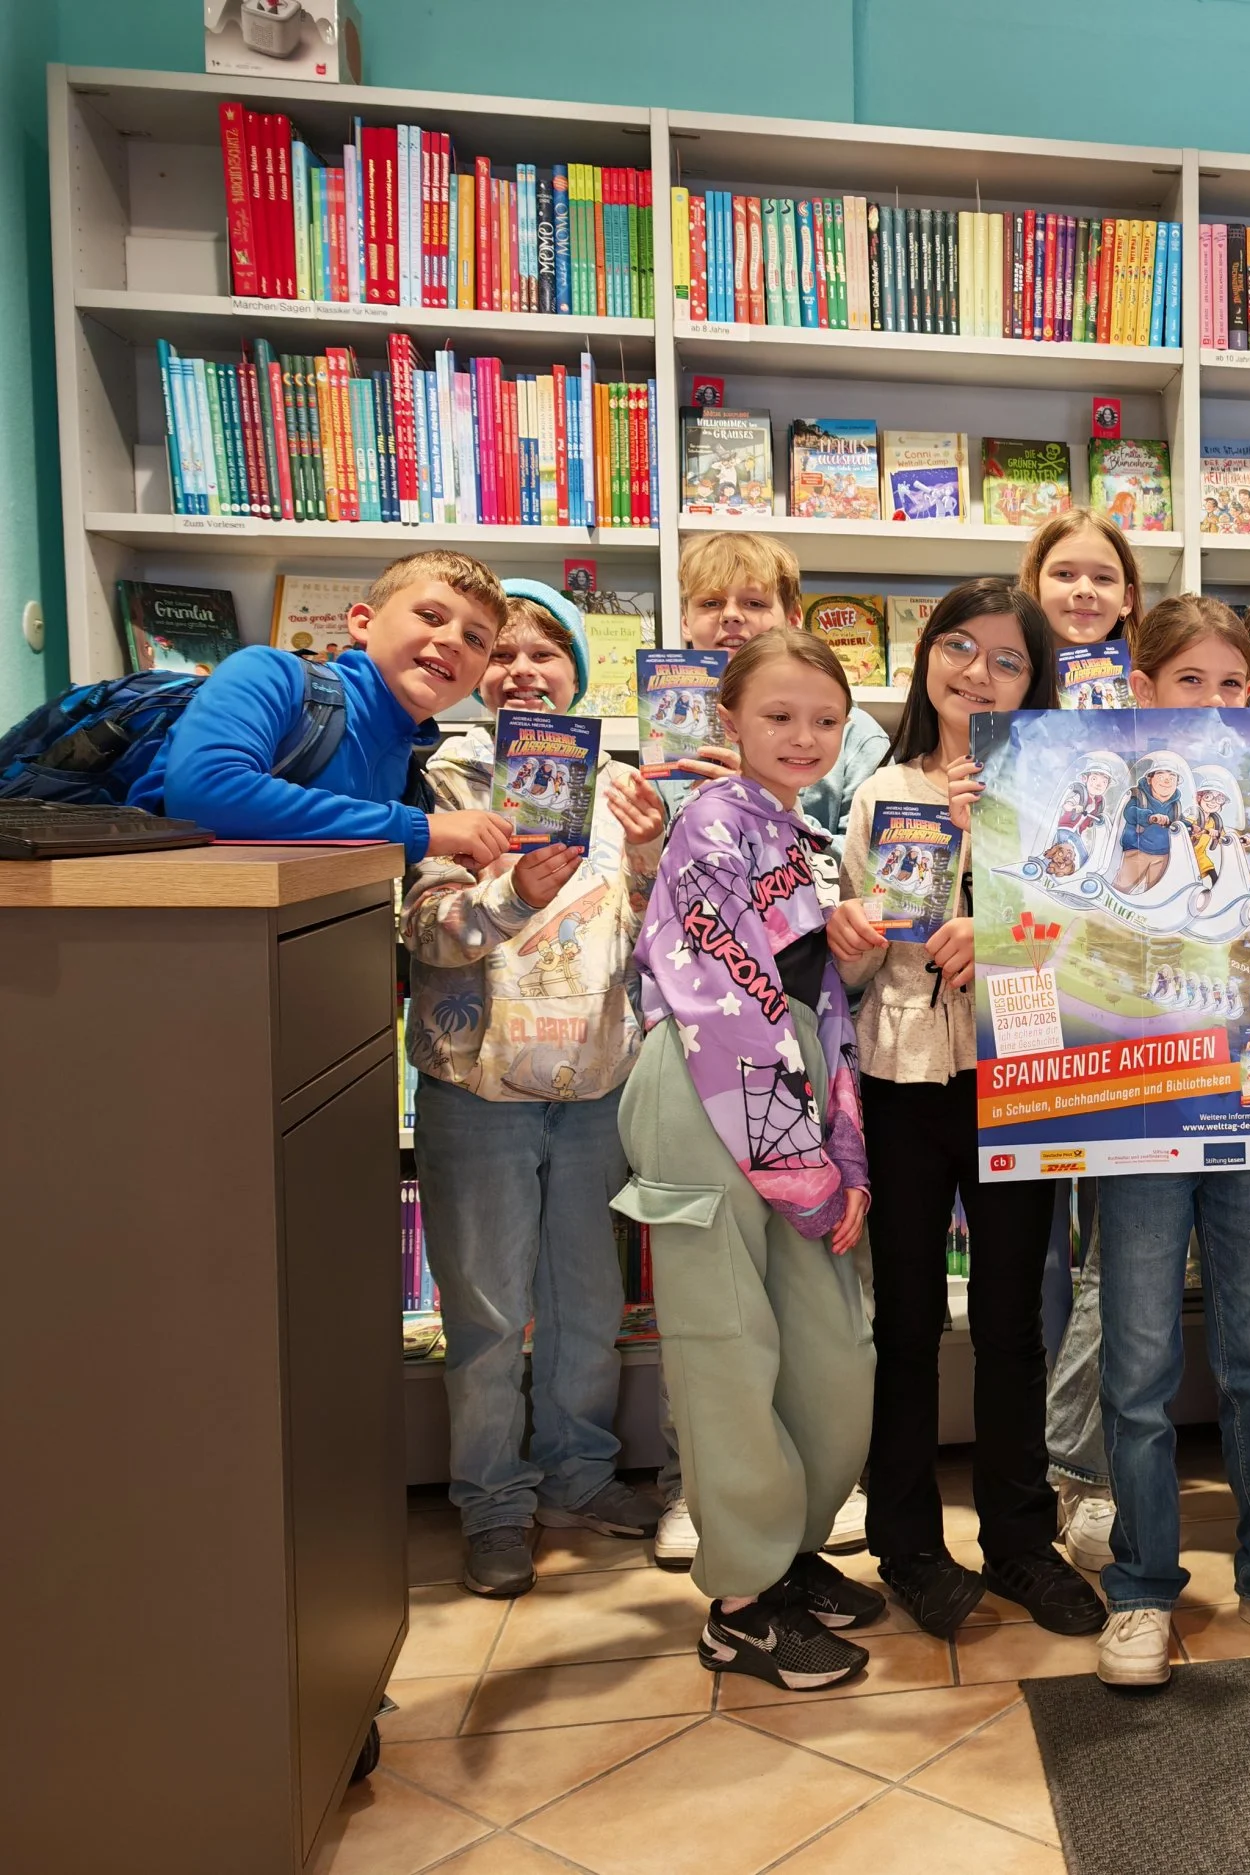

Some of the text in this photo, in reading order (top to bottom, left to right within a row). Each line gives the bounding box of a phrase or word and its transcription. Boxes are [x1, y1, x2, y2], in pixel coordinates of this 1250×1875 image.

[556, 202, 569, 256] MOMO
[709, 326, 729, 334] Jahre
[697, 418, 747, 428] WILLKOMMEN
[713, 430, 754, 440] GRAUSES
[905, 451, 931, 459] Conni
[1025, 450, 1036, 458] DIE
[1008, 457, 1037, 469] GRÜNEN
[1109, 456, 1154, 470] Blumenherz
[1013, 469, 1058, 482] PIRATEN
[154, 600, 216, 622] Grimlin
[288, 614, 336, 626] Das große
[620, 627, 636, 636] Bär
[992, 974, 1052, 997] WELTTAG
[995, 998, 1006, 1014] DES
[1007, 993, 1055, 1012] BUCHES
[997, 1012, 1057, 1030] 23/04/2026
[1000, 1026, 1058, 1042] ich schenk dir
[1000, 1036, 1060, 1052] eine Geschichte
[992, 1036, 1216, 1090] SPANNENDE AKTIONEN
[992, 1075, 1231, 1118] in Schulen, Buchhandlungen und Bibliotheken
[1200, 1113, 1226, 1121] Weitere
[994, 1157, 1014, 1168] cbj
[1047, 1163, 1079, 1172] DHL
